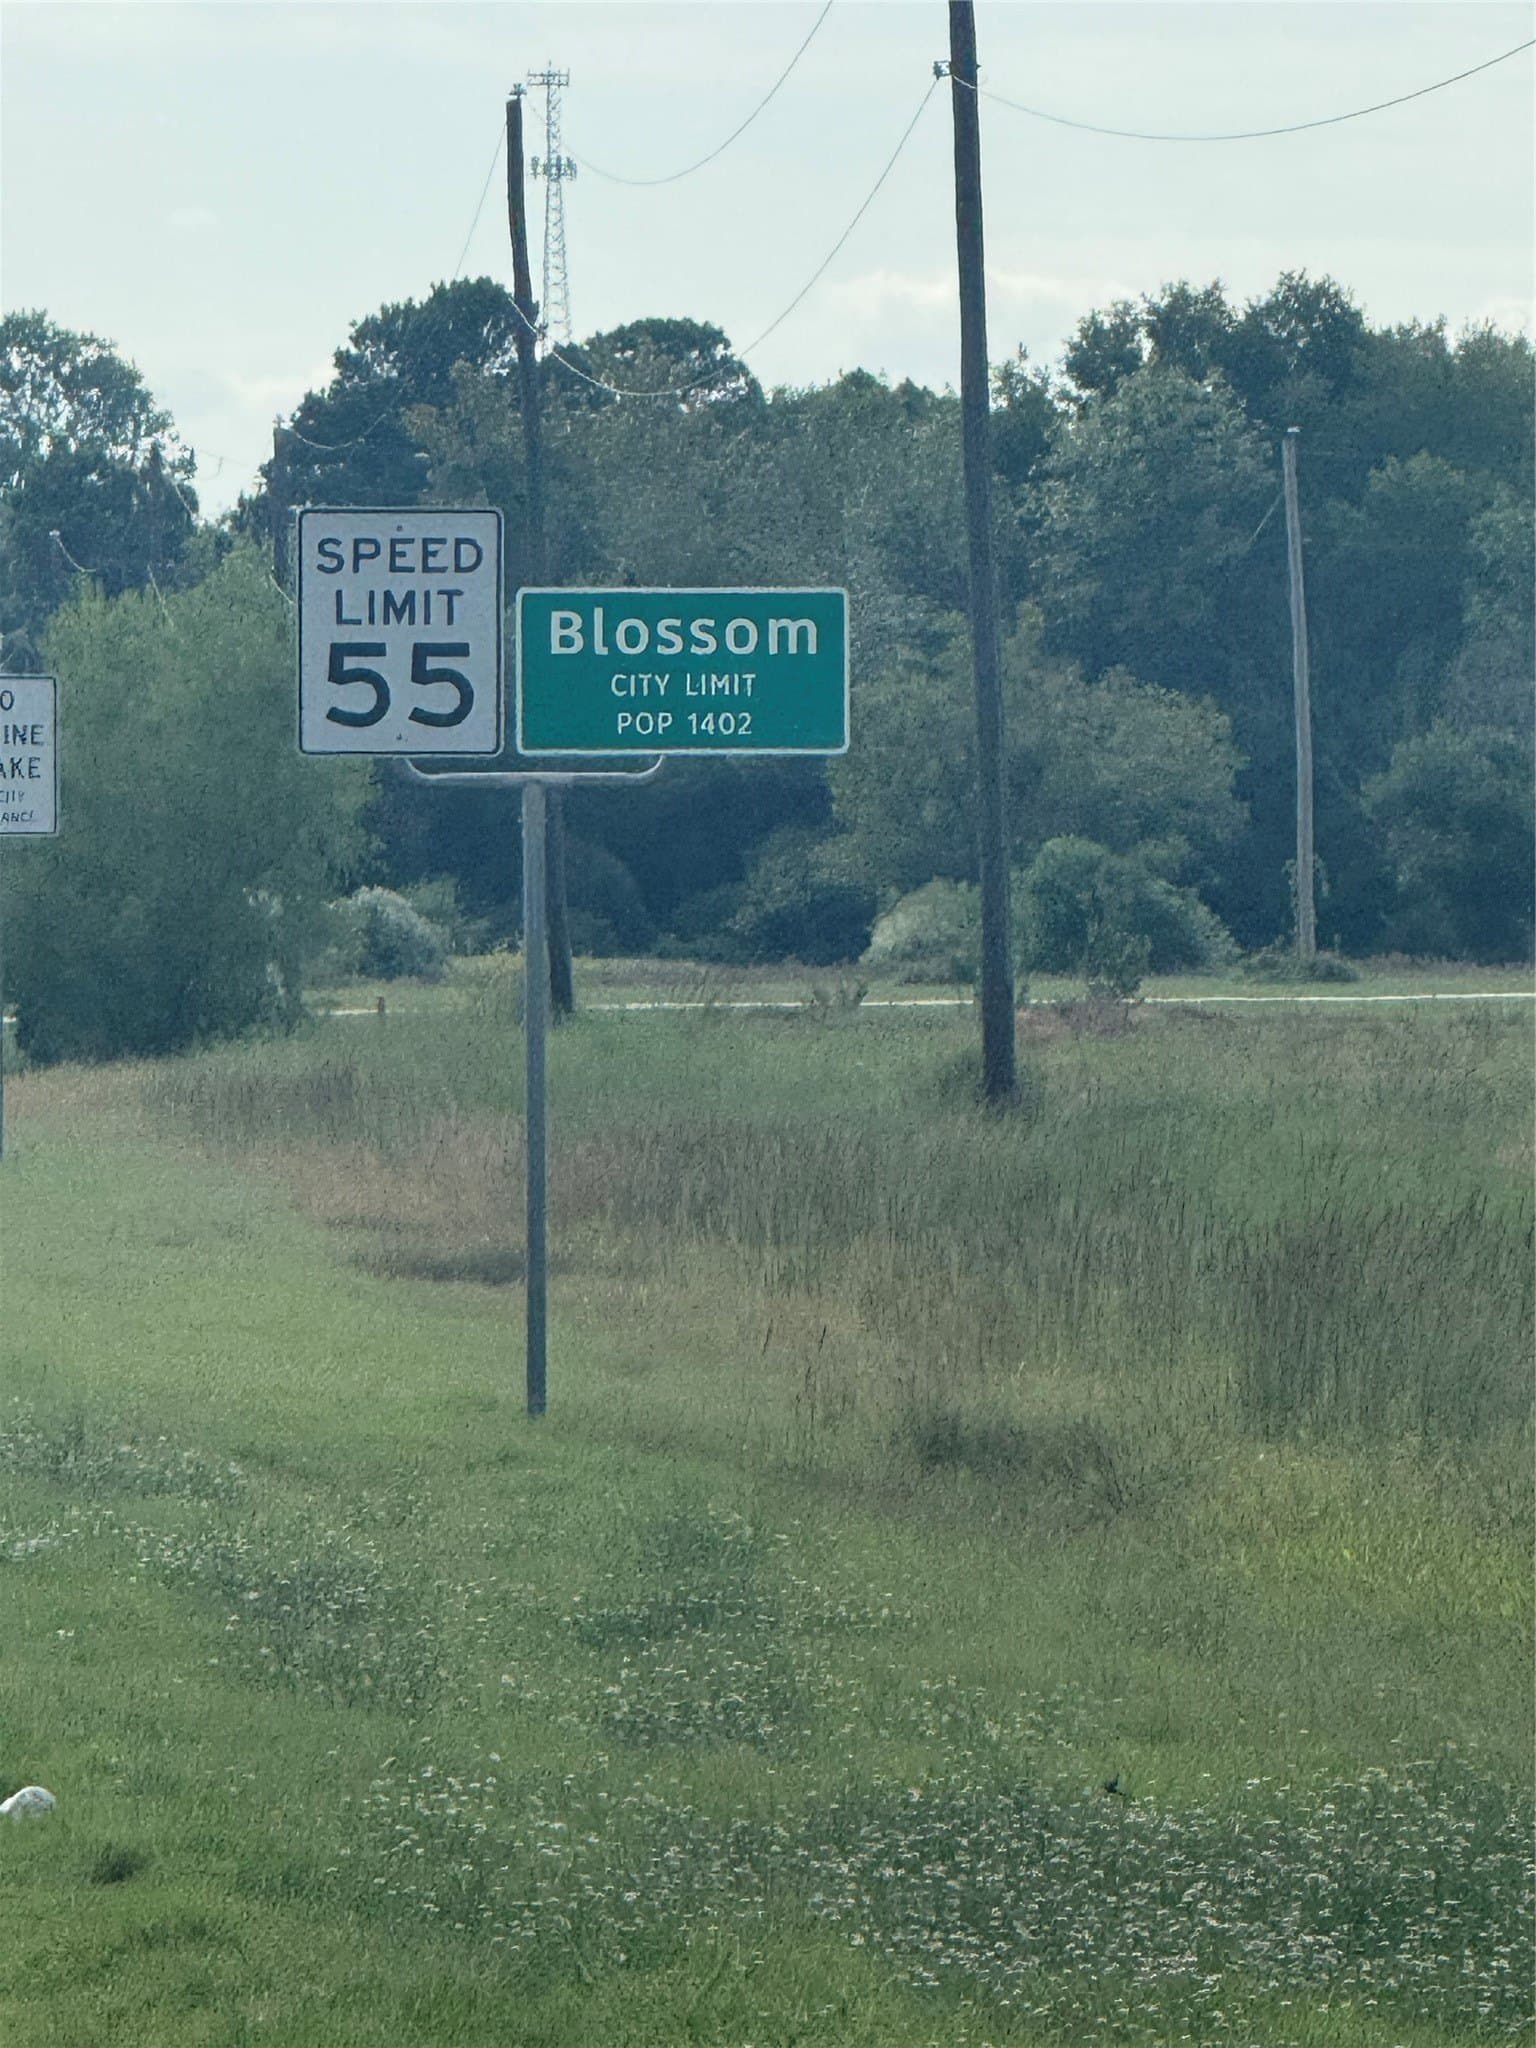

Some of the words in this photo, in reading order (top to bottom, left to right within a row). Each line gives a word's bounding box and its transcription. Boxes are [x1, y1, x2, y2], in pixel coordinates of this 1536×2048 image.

[316, 537, 483, 575] SPEED
[335, 589, 464, 626] LIMIT
[550, 607, 818, 655] Blossom
[325, 642, 475, 728] 55
[611, 673, 670, 697] CITY
[686, 673, 756, 697] LIMIT
[617, 711, 673, 735] POP
[688, 711, 753, 735] 1402
